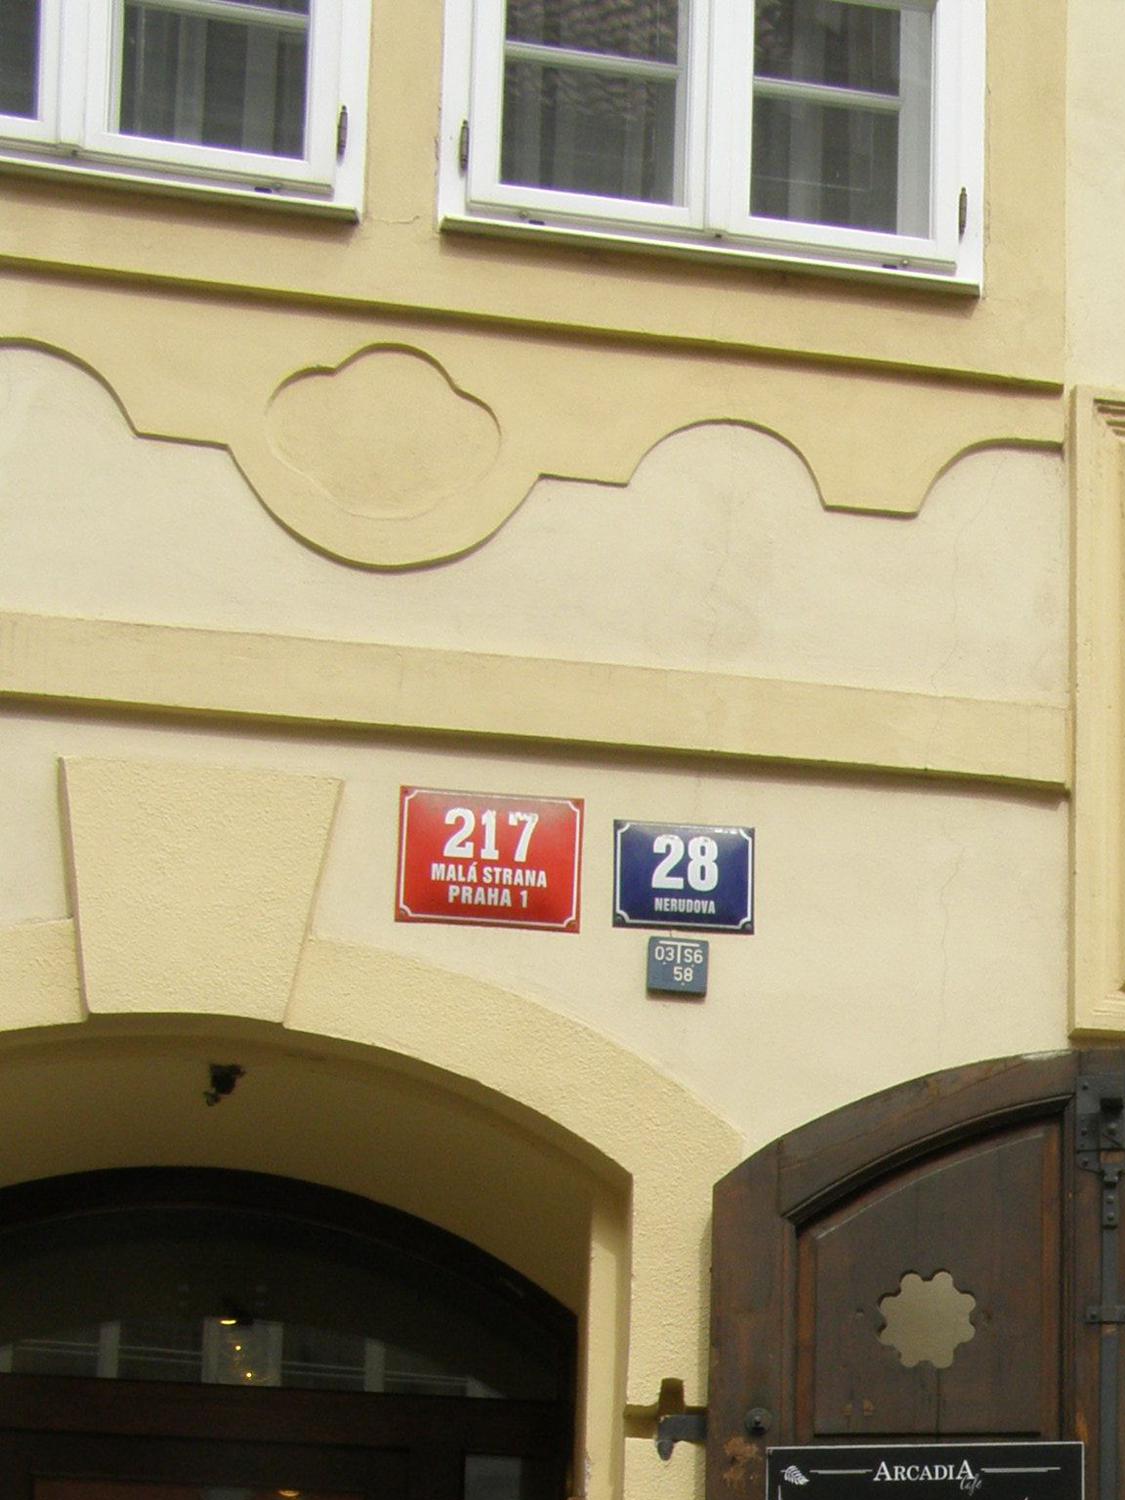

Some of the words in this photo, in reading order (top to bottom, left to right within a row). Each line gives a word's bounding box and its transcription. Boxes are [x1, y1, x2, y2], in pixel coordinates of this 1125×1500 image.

[443, 807, 539, 862] 217
[431, 861, 478, 882] MALÁ
[482, 866, 547, 888] STRANA
[652, 834, 718, 892] 28
[448, 885, 512, 907] PRAHA
[520, 890, 528, 908] 1
[654, 897, 716, 914] NERUDOVA
[673, 966, 694, 982] 58
